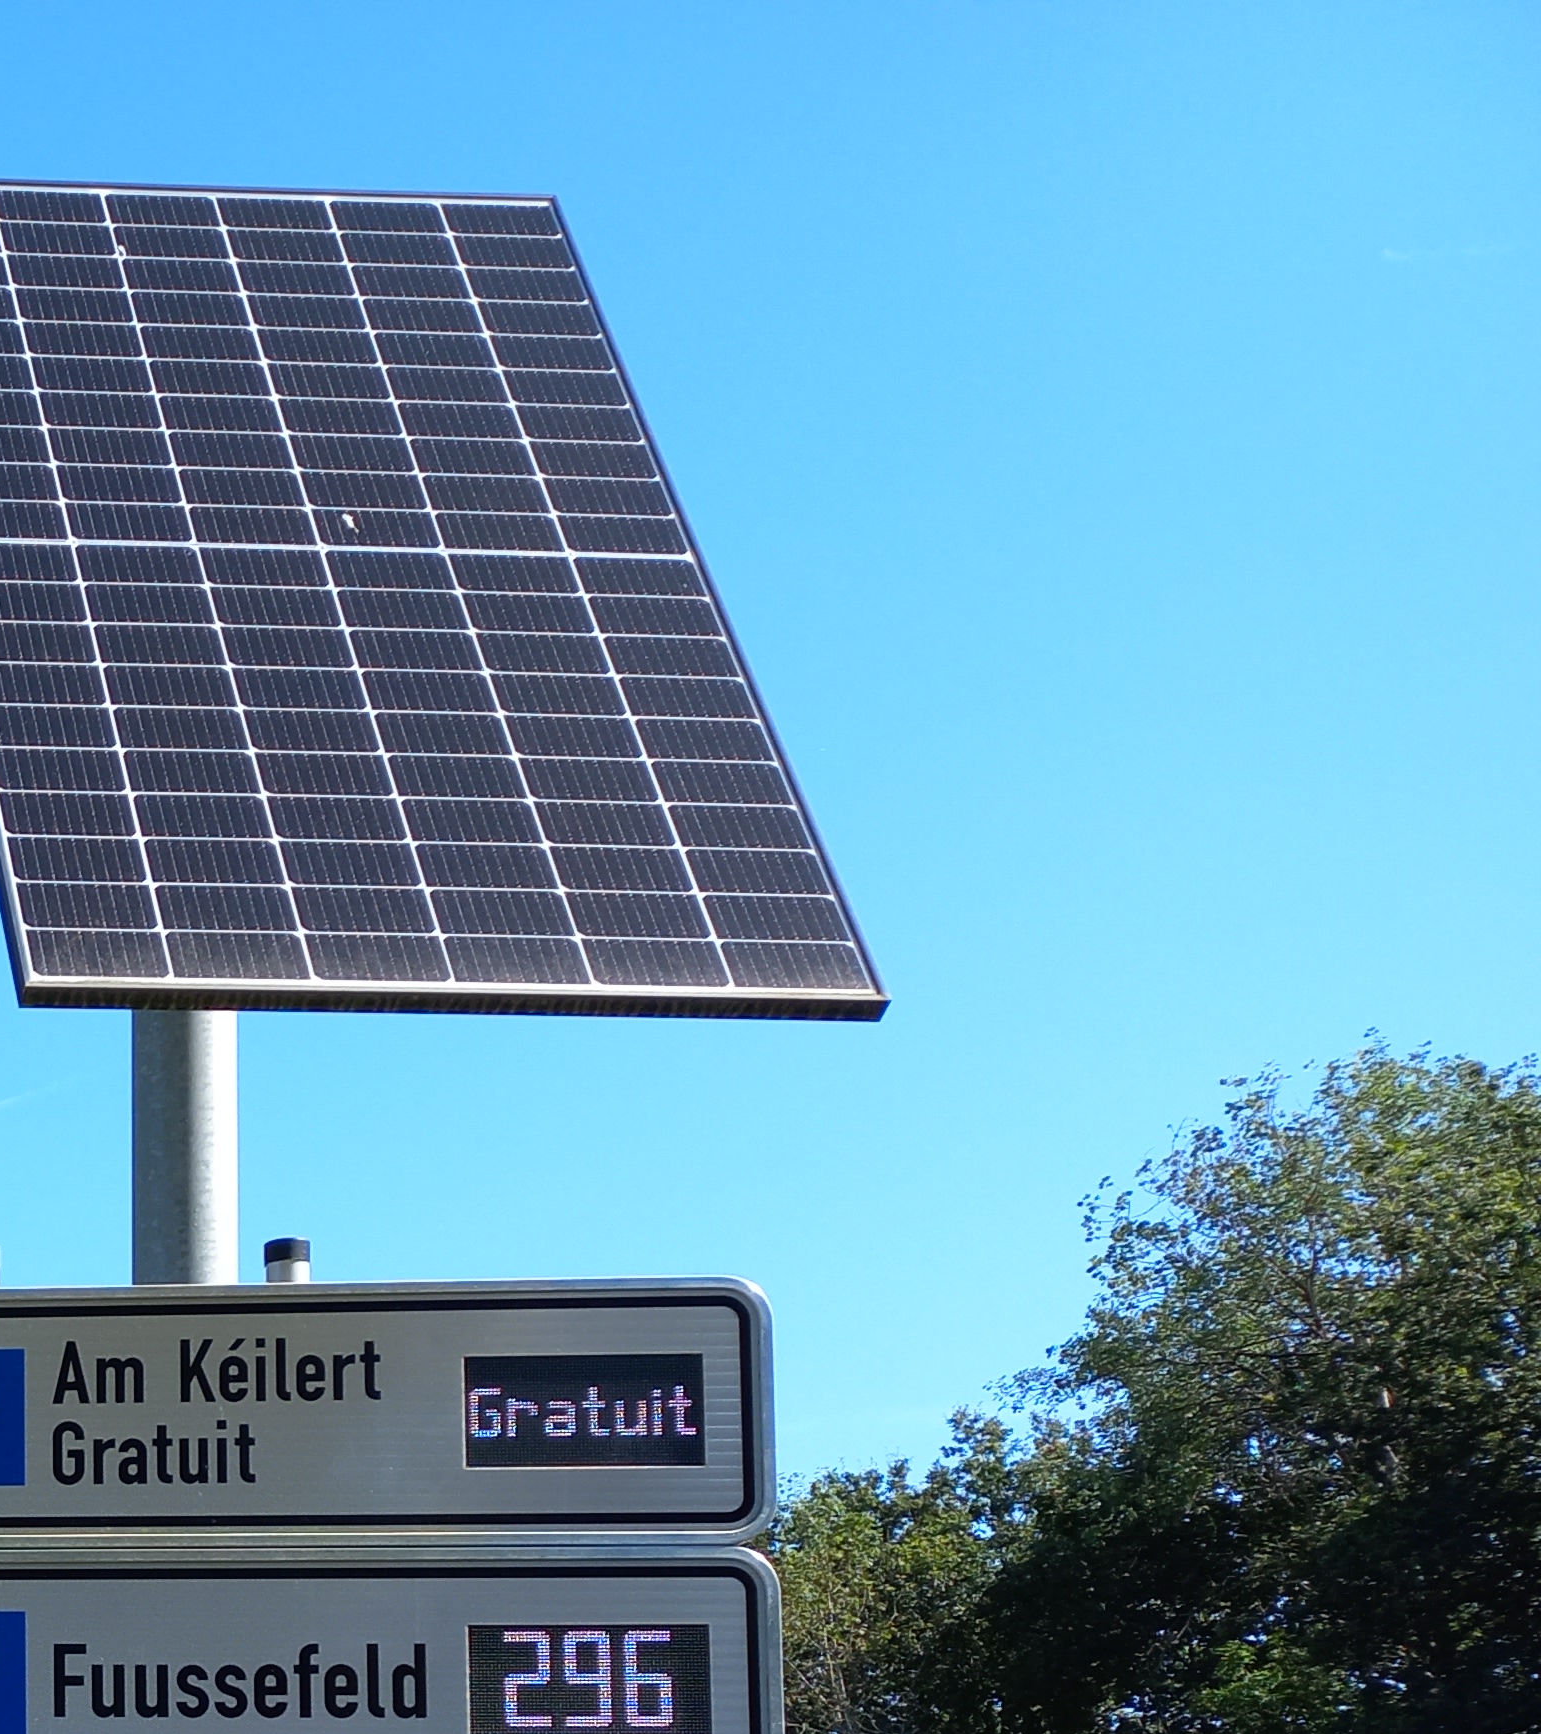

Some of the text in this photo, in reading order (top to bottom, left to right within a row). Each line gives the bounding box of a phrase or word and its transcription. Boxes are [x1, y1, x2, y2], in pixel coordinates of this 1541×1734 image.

[51, 1336, 383, 1405] Am Kéilert
[468, 1382, 698, 1440] Gratuit
[51, 1419, 258, 1487] Gratuit
[52, 1642, 428, 1721] Fuussefeld
[501, 1628, 675, 1730] 296
